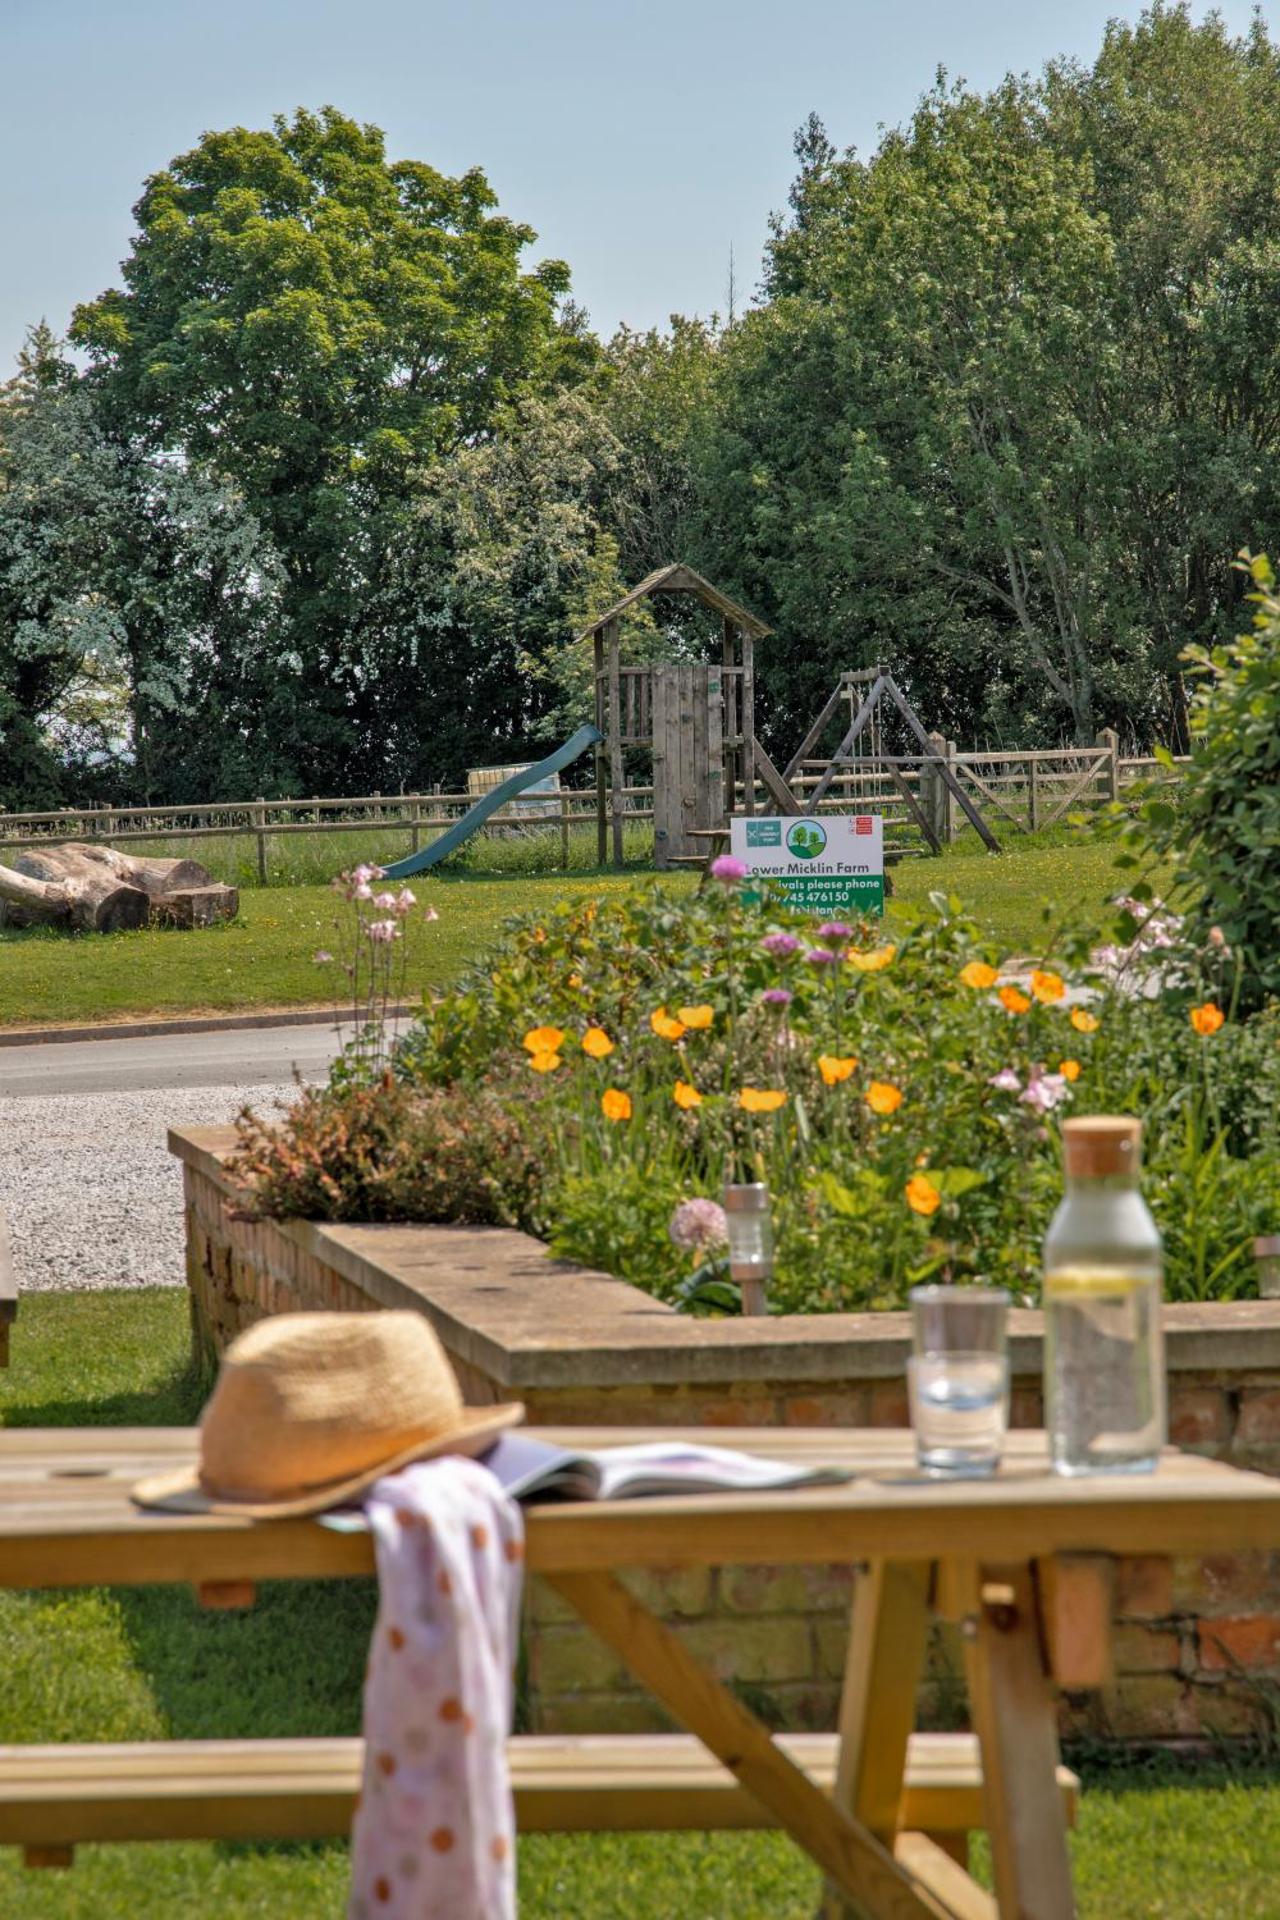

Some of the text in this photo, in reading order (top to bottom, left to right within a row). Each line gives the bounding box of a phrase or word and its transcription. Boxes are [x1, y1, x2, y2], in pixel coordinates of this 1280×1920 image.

[745, 862, 870, 875] Lower Micklin Farm
[807, 878, 843, 892] please
[845, 877, 880, 891] phone
[806, 891, 849, 903] 476150
